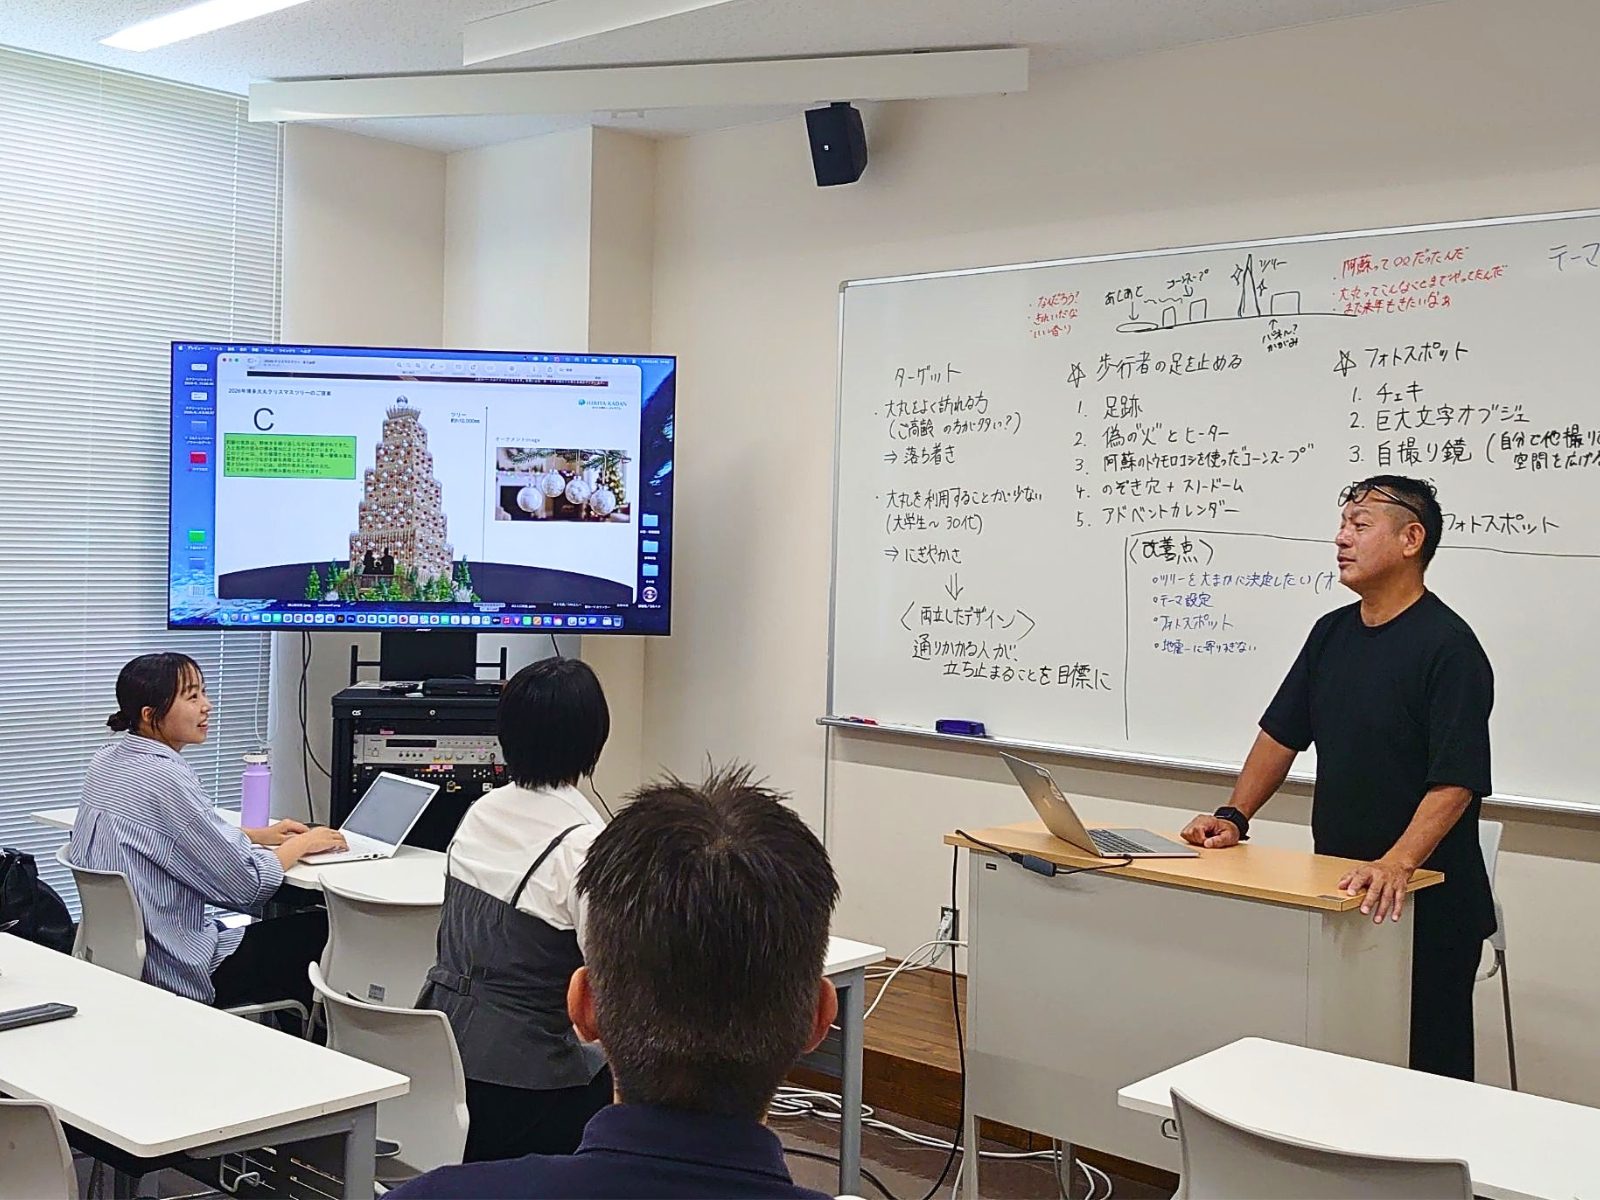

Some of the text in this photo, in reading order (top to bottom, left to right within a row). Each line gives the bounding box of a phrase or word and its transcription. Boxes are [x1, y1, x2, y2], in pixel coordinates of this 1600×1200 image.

[1549, 242, 1600, 271] テーマ
[1105, 286, 1144, 305] あしあと
[1097, 351, 1242, 382] 歩行者の足を止める
[1365, 341, 1468, 368] フォトスポット
[895, 362, 962, 387] ターゲット
[1376, 380, 1423, 404] チェキ
[253, 407, 274, 431] C
[1104, 394, 1143, 419] 足跡
[1377, 403, 1530, 431] 巨大文字オブジェ
[904, 442, 955, 466] 落ち着き
[1378, 437, 1472, 467] 自撮り鏡
[1102, 500, 1240, 524] アドベントカレンダー
[905, 544, 962, 565] にぎやかさ
[943, 661, 1112, 690] 立ち止まることを目標に
